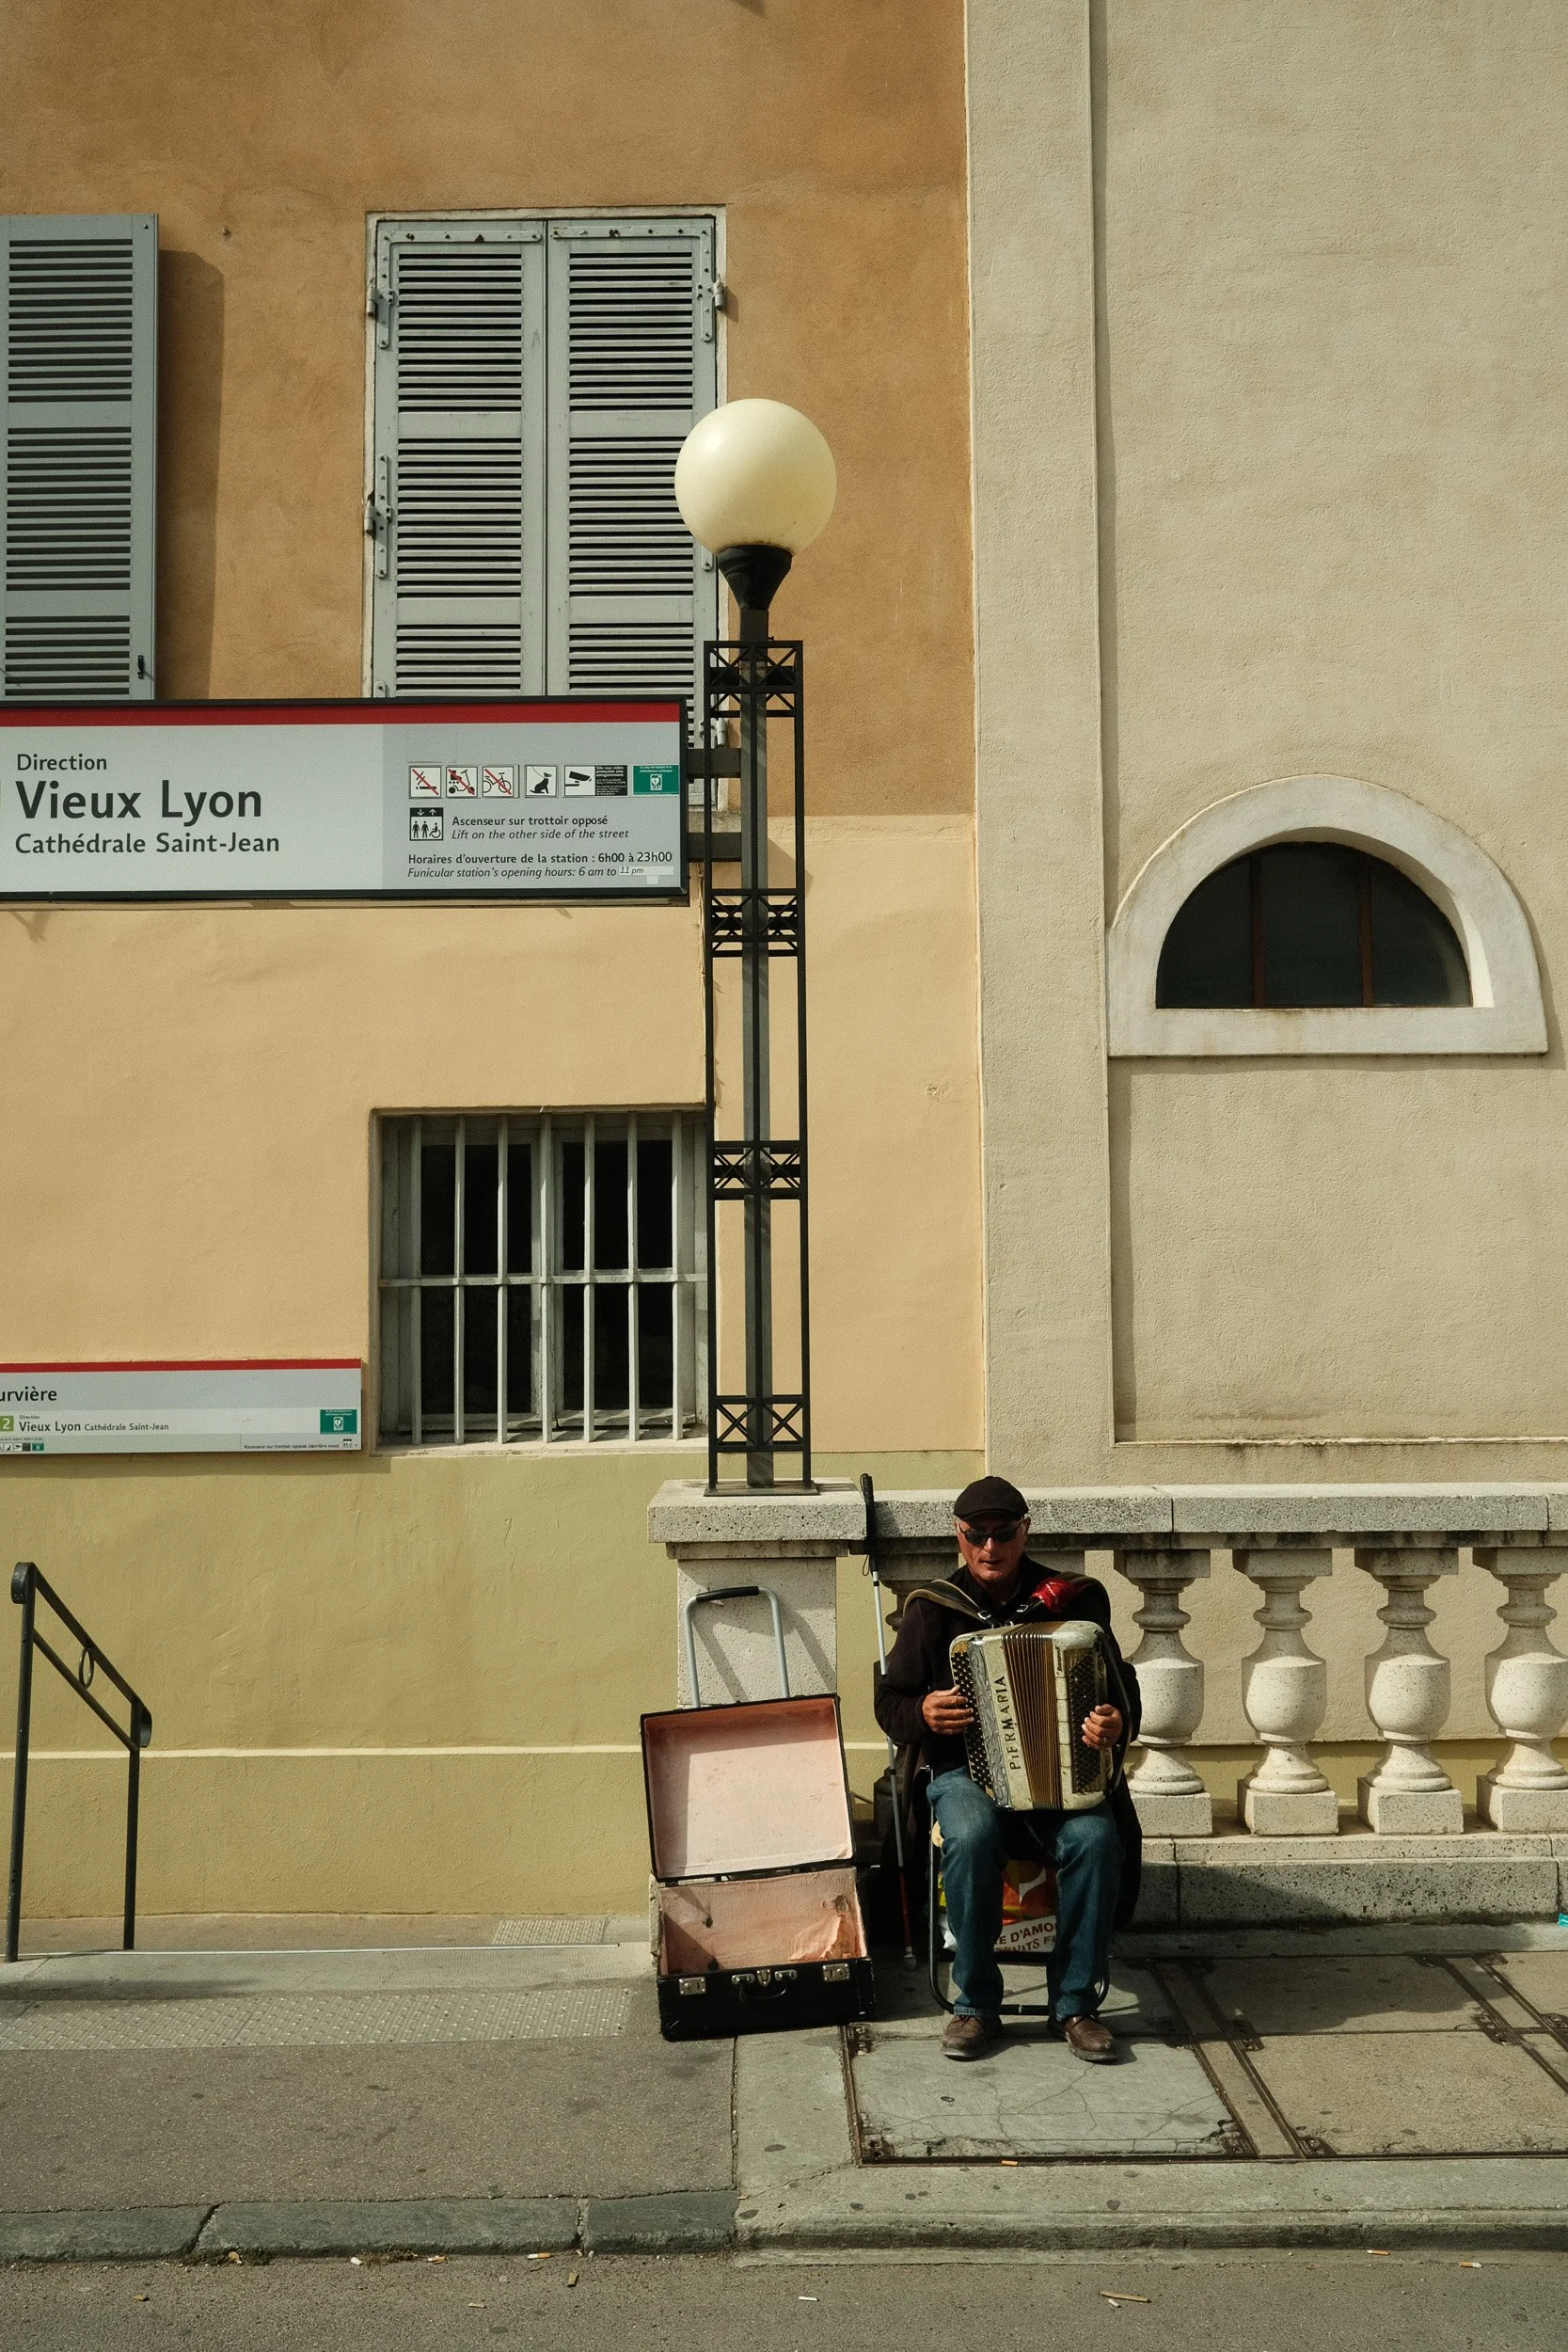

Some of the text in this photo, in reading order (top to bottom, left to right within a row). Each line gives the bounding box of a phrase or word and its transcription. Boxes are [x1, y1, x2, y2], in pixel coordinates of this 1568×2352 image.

[17, 754, 107, 771] Direction
[14, 780, 261, 828] Vieux Lyon
[451, 817, 506, 826] Ascenseur
[528, 816, 570, 826] trottoir
[571, 816, 609, 828] opposé
[451, 830, 468, 840] Lift
[488, 830, 506, 839] the
[508, 830, 538, 839] other
[540, 829, 562, 839] side
[563, 829, 577, 839] of
[578, 829, 595, 839] the
[598, 831, 629, 839] street
[15, 833, 279, 854] Cathédrale Saint-Jean
[408, 854, 452, 865] Horaires
[455, 854, 517, 864] d'ouverture
[520, 854, 534, 864] de
[537, 854, 547, 864] la
[550, 853, 589, 864] station
[597, 853, 626, 863] 6h00
[627, 853, 635, 863] à
[637, 851, 673, 863] 23h00
[407, 868, 455, 878] Funicular
[456, 867, 499, 878] station's
[500, 867, 543, 880] opening
[544, 867, 576, 877] hours:
[578, 866, 586, 877] 6
[607, 868, 617, 877] to
[3, 1418, 10, 1430] 2
[19, 1422, 51, 1432] Vieux
[55, 1422, 81, 1434] Lyon
[84, 1423, 127, 1432] Cathédrale
